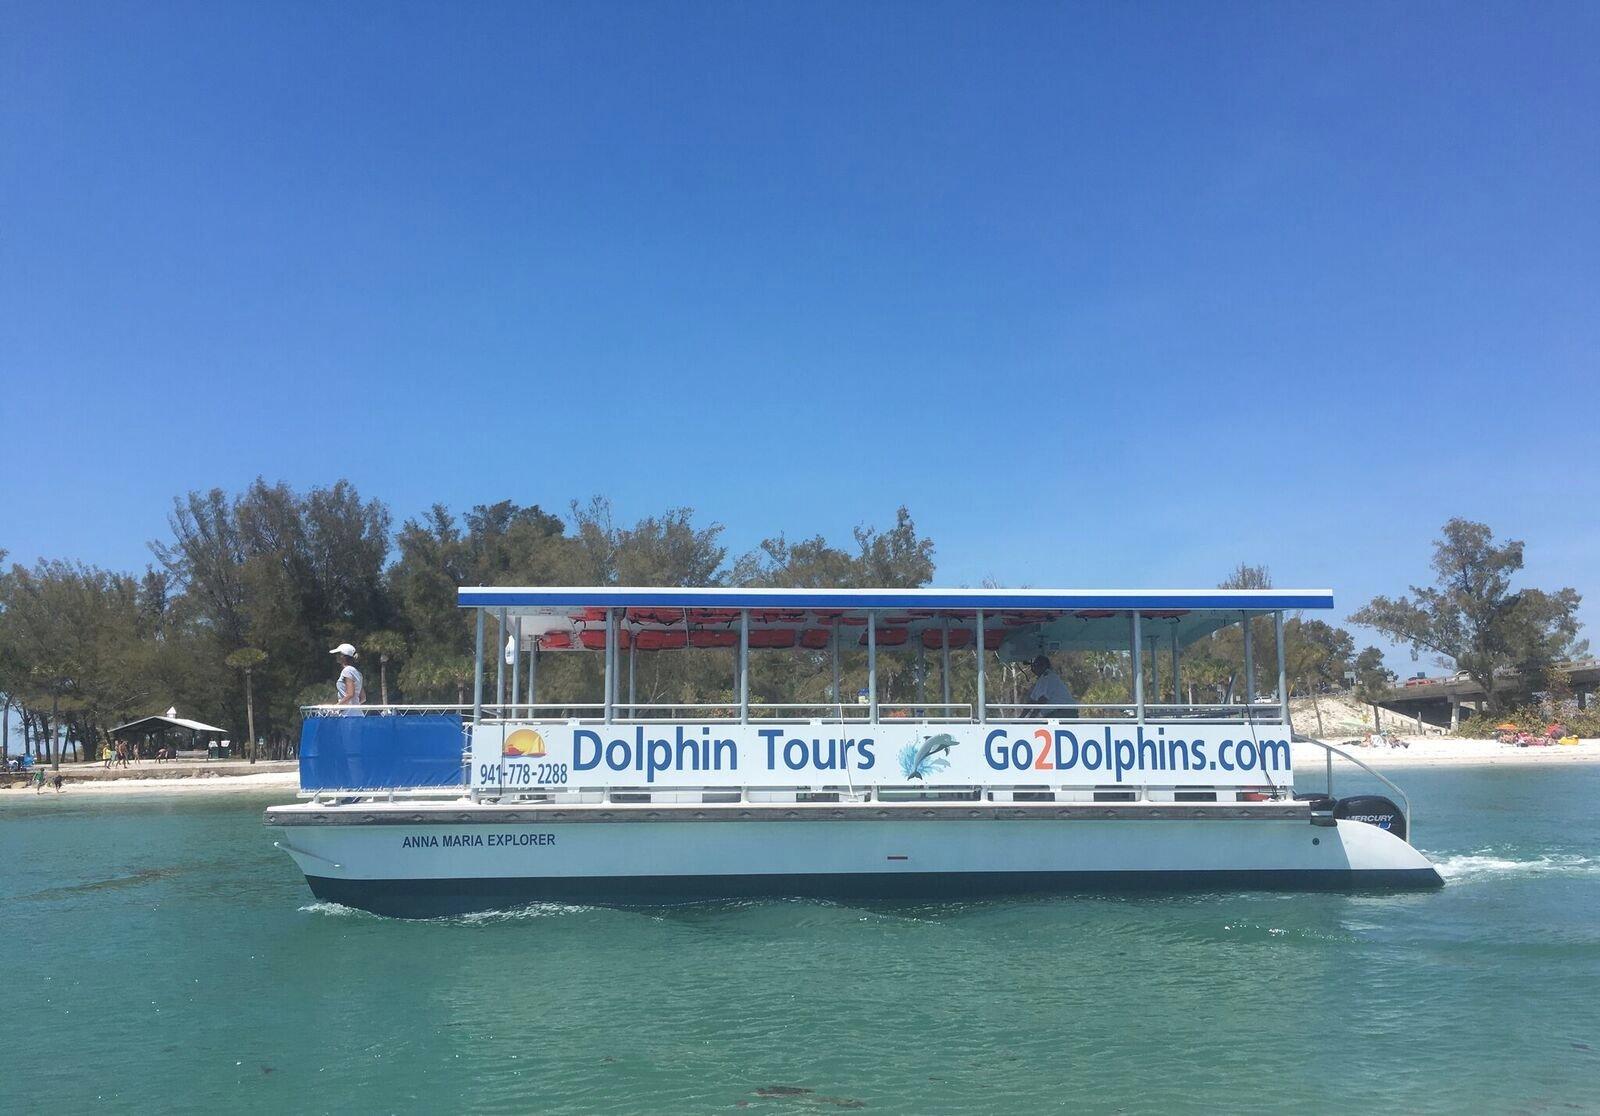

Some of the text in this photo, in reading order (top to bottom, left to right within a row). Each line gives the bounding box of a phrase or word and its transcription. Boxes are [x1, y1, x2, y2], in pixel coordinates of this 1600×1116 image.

[573, 726, 876, 782] Dolphin Tours
[984, 726, 1291, 782] Go2Dolphins.com
[480, 763, 568, 785] 941-778-2288
[402, 833, 556, 848] ANNA MARIA EXPLORER
